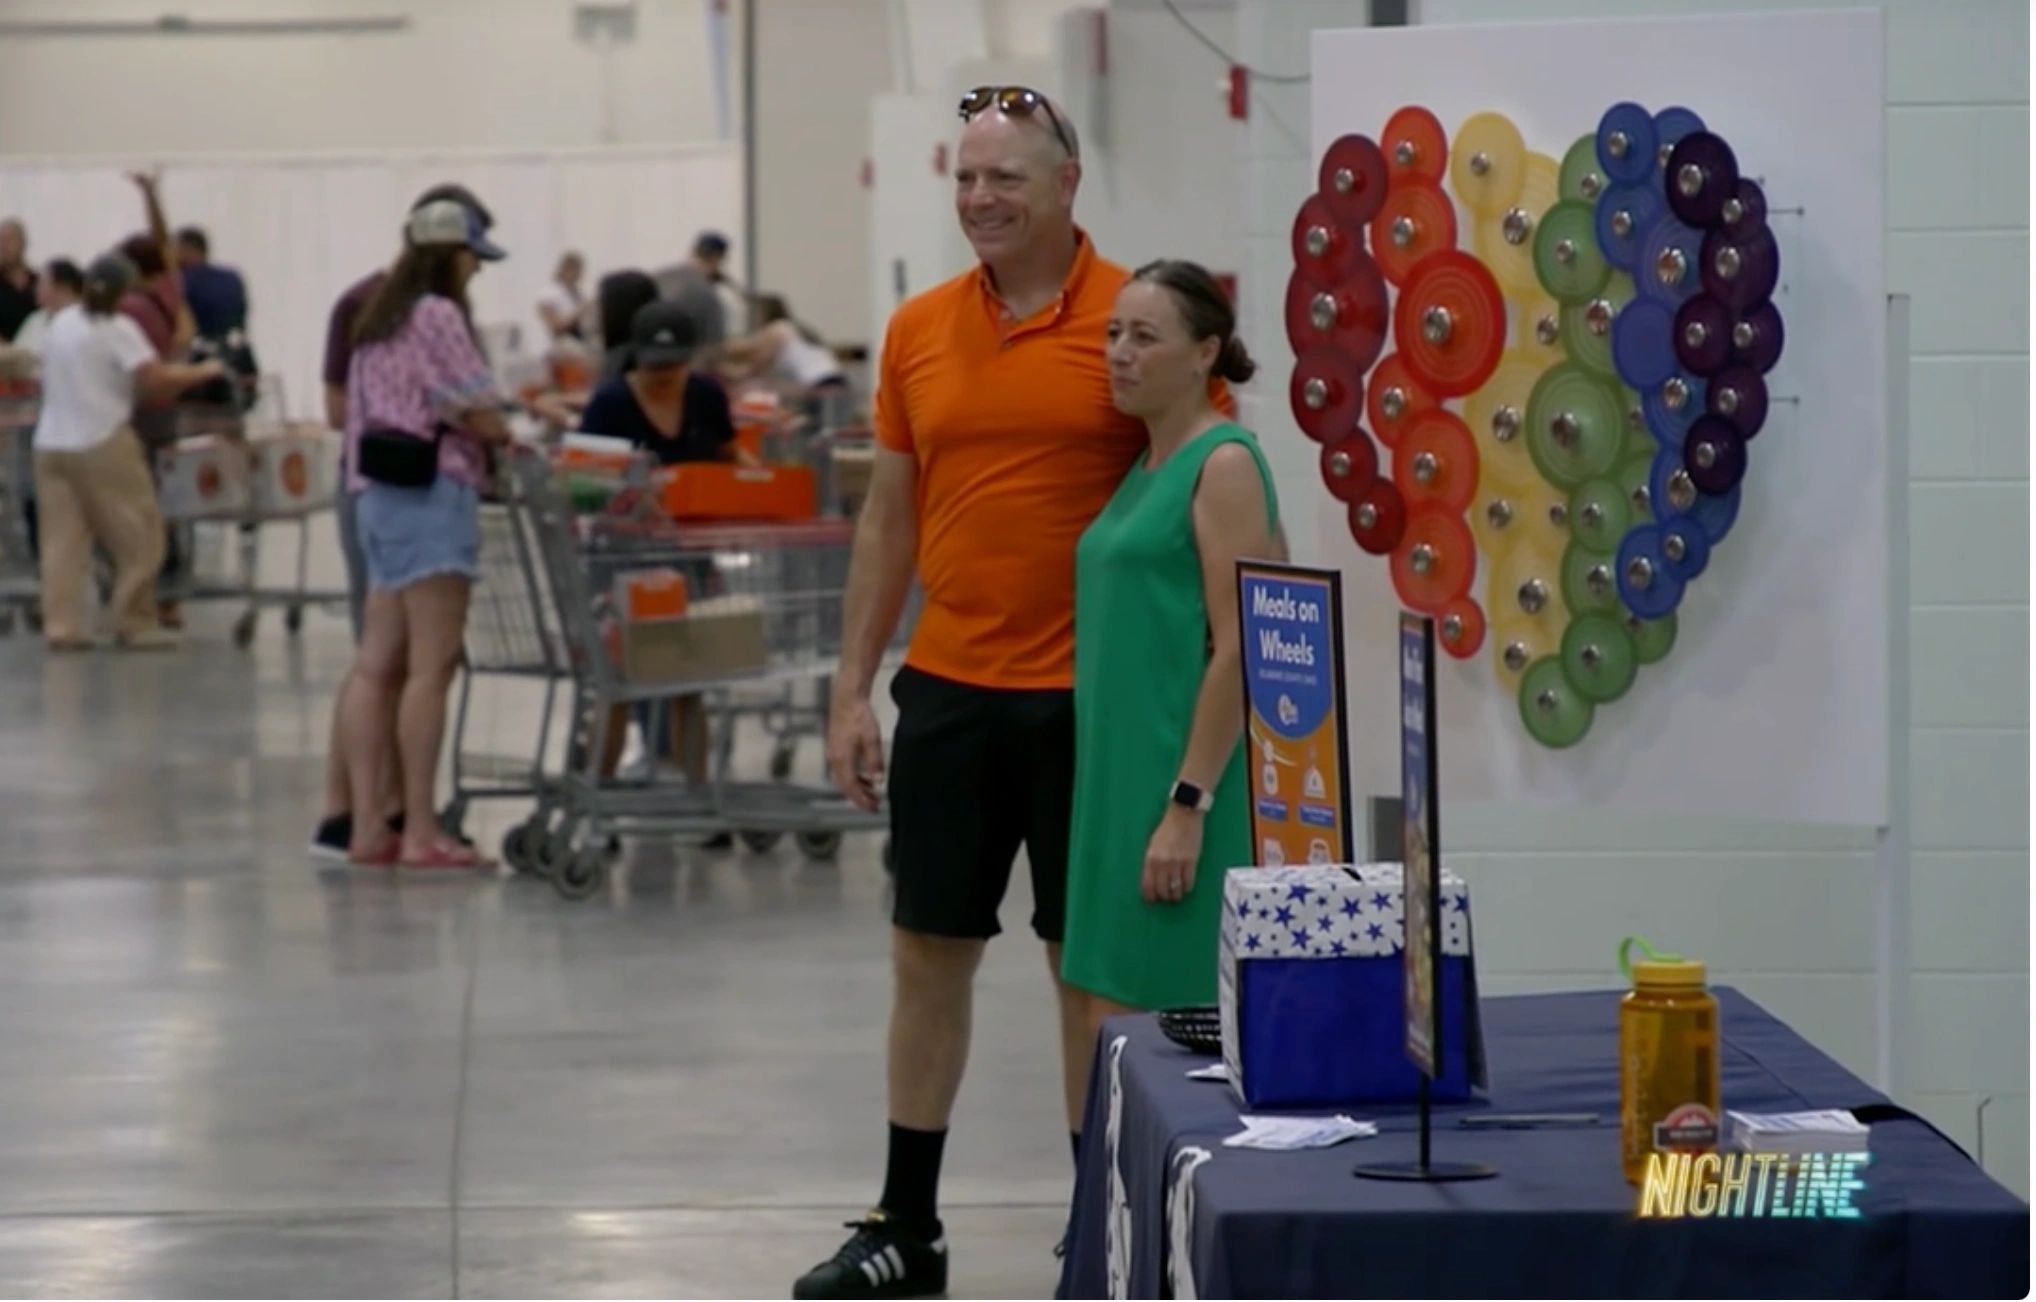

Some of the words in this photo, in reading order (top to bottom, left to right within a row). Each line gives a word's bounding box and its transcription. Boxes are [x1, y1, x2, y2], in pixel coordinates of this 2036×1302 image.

[1252, 585, 1297, 621] Meals
[1298, 600, 1320, 623] on
[1259, 629, 1315, 666] Wheels
